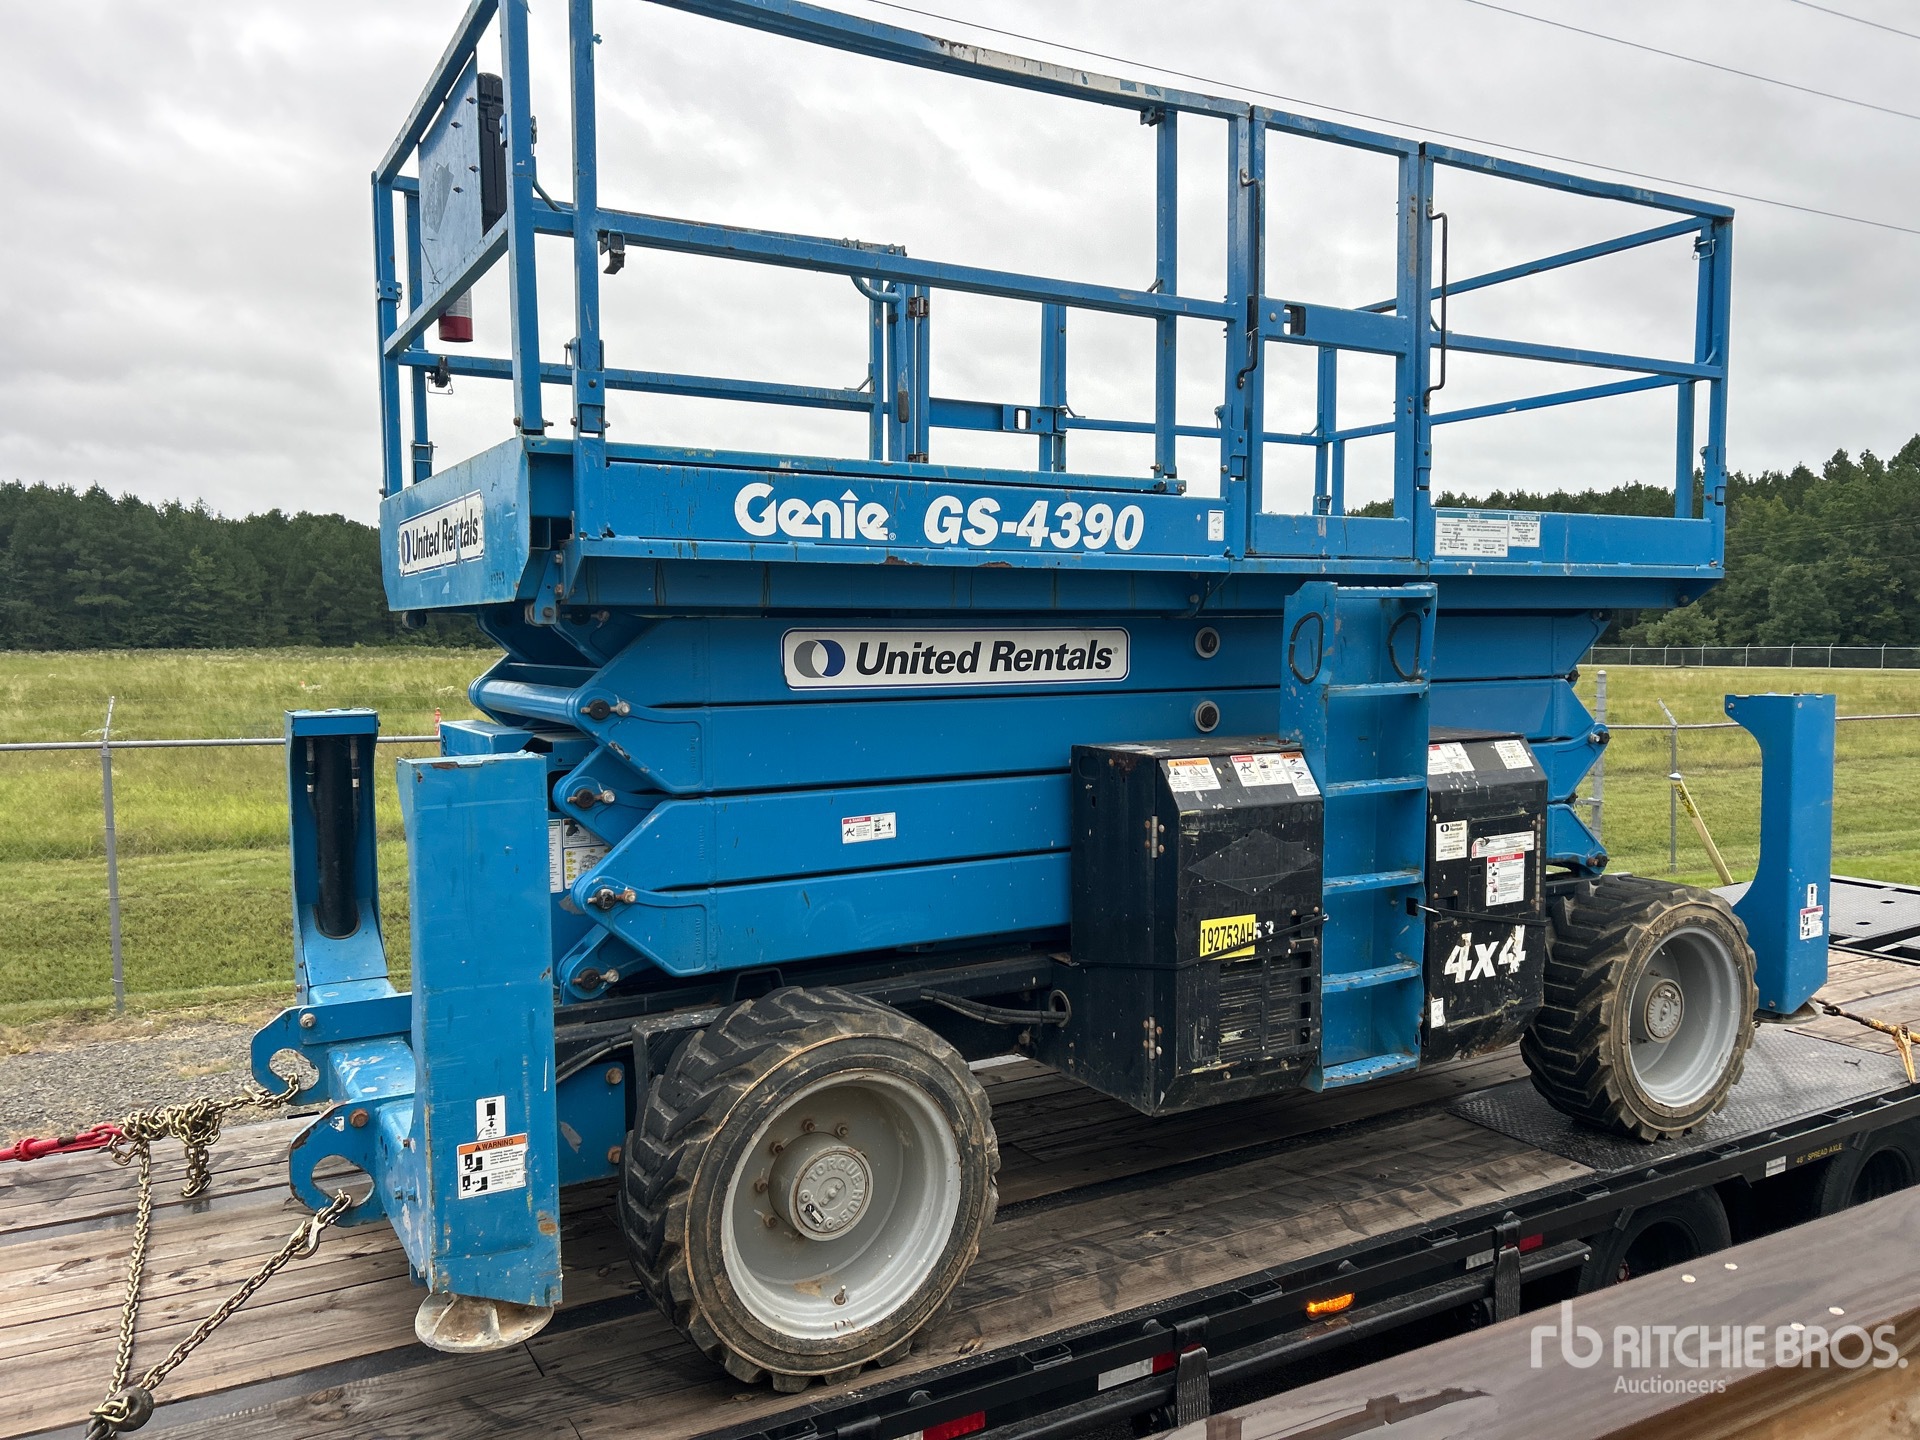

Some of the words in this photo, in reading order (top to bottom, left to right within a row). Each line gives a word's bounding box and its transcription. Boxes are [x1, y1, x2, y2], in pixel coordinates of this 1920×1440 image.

[734, 483, 889, 540] Genie
[923, 495, 1144, 550] GS-4390
[412, 521, 439, 561] United
[856, 641, 981, 675] United
[989, 639, 1113, 672] Rentals
[1202, 922, 1254, 953] 192753AH
[1444, 924, 1527, 984] 4x4
[482, 1138, 514, 1150] WARNING
[1807, 1148, 1828, 1161] SPREAD
[1828, 1143, 1843, 1153] AXLE
